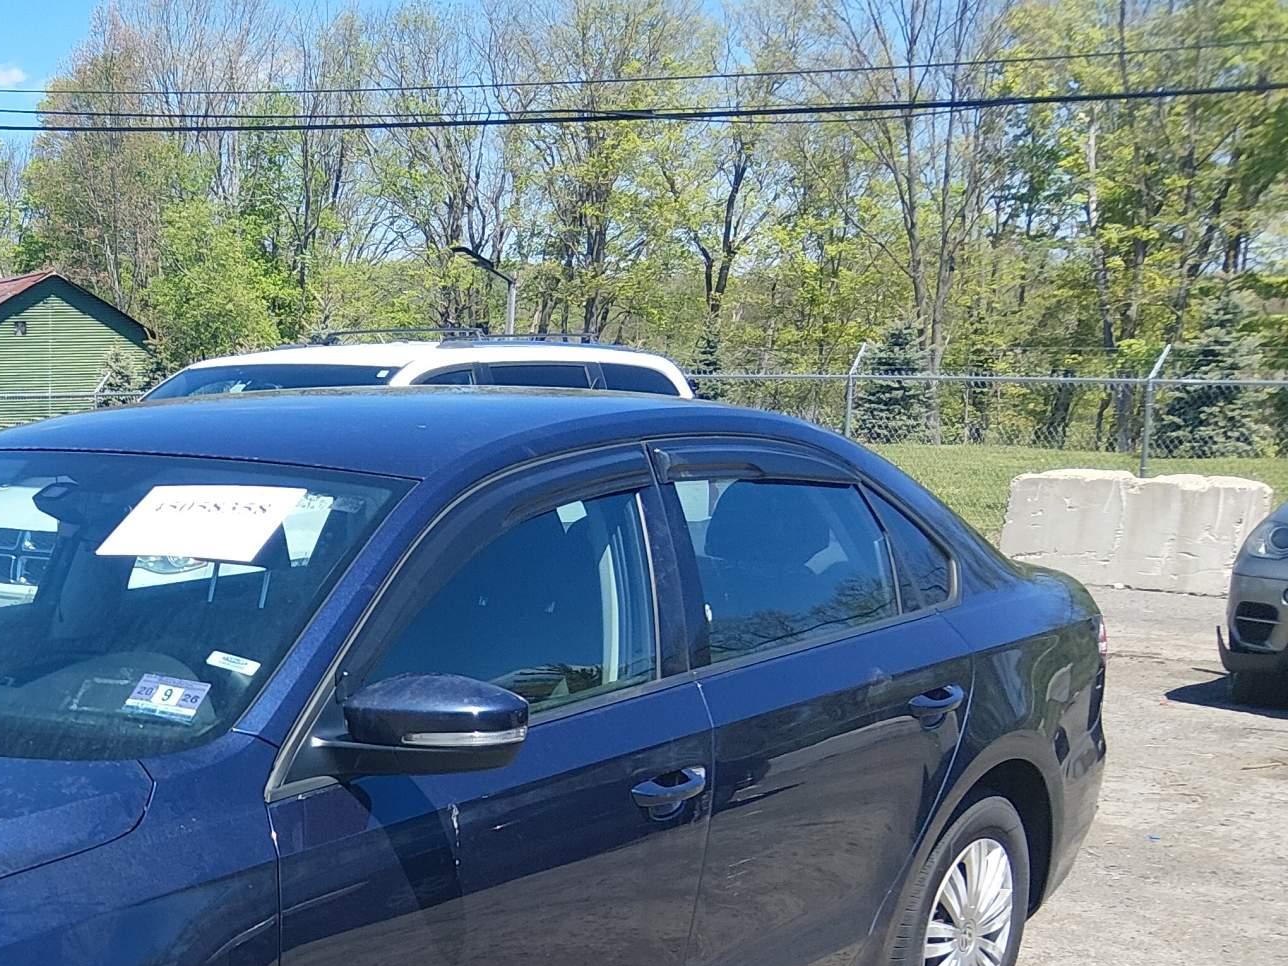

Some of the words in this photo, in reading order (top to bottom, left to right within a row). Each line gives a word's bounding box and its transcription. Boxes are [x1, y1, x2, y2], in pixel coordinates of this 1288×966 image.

[154, 500, 273, 515] 505858
[137, 686, 154, 696] 20
[161, 688, 174, 702] 9
[181, 693, 200, 704] 26
